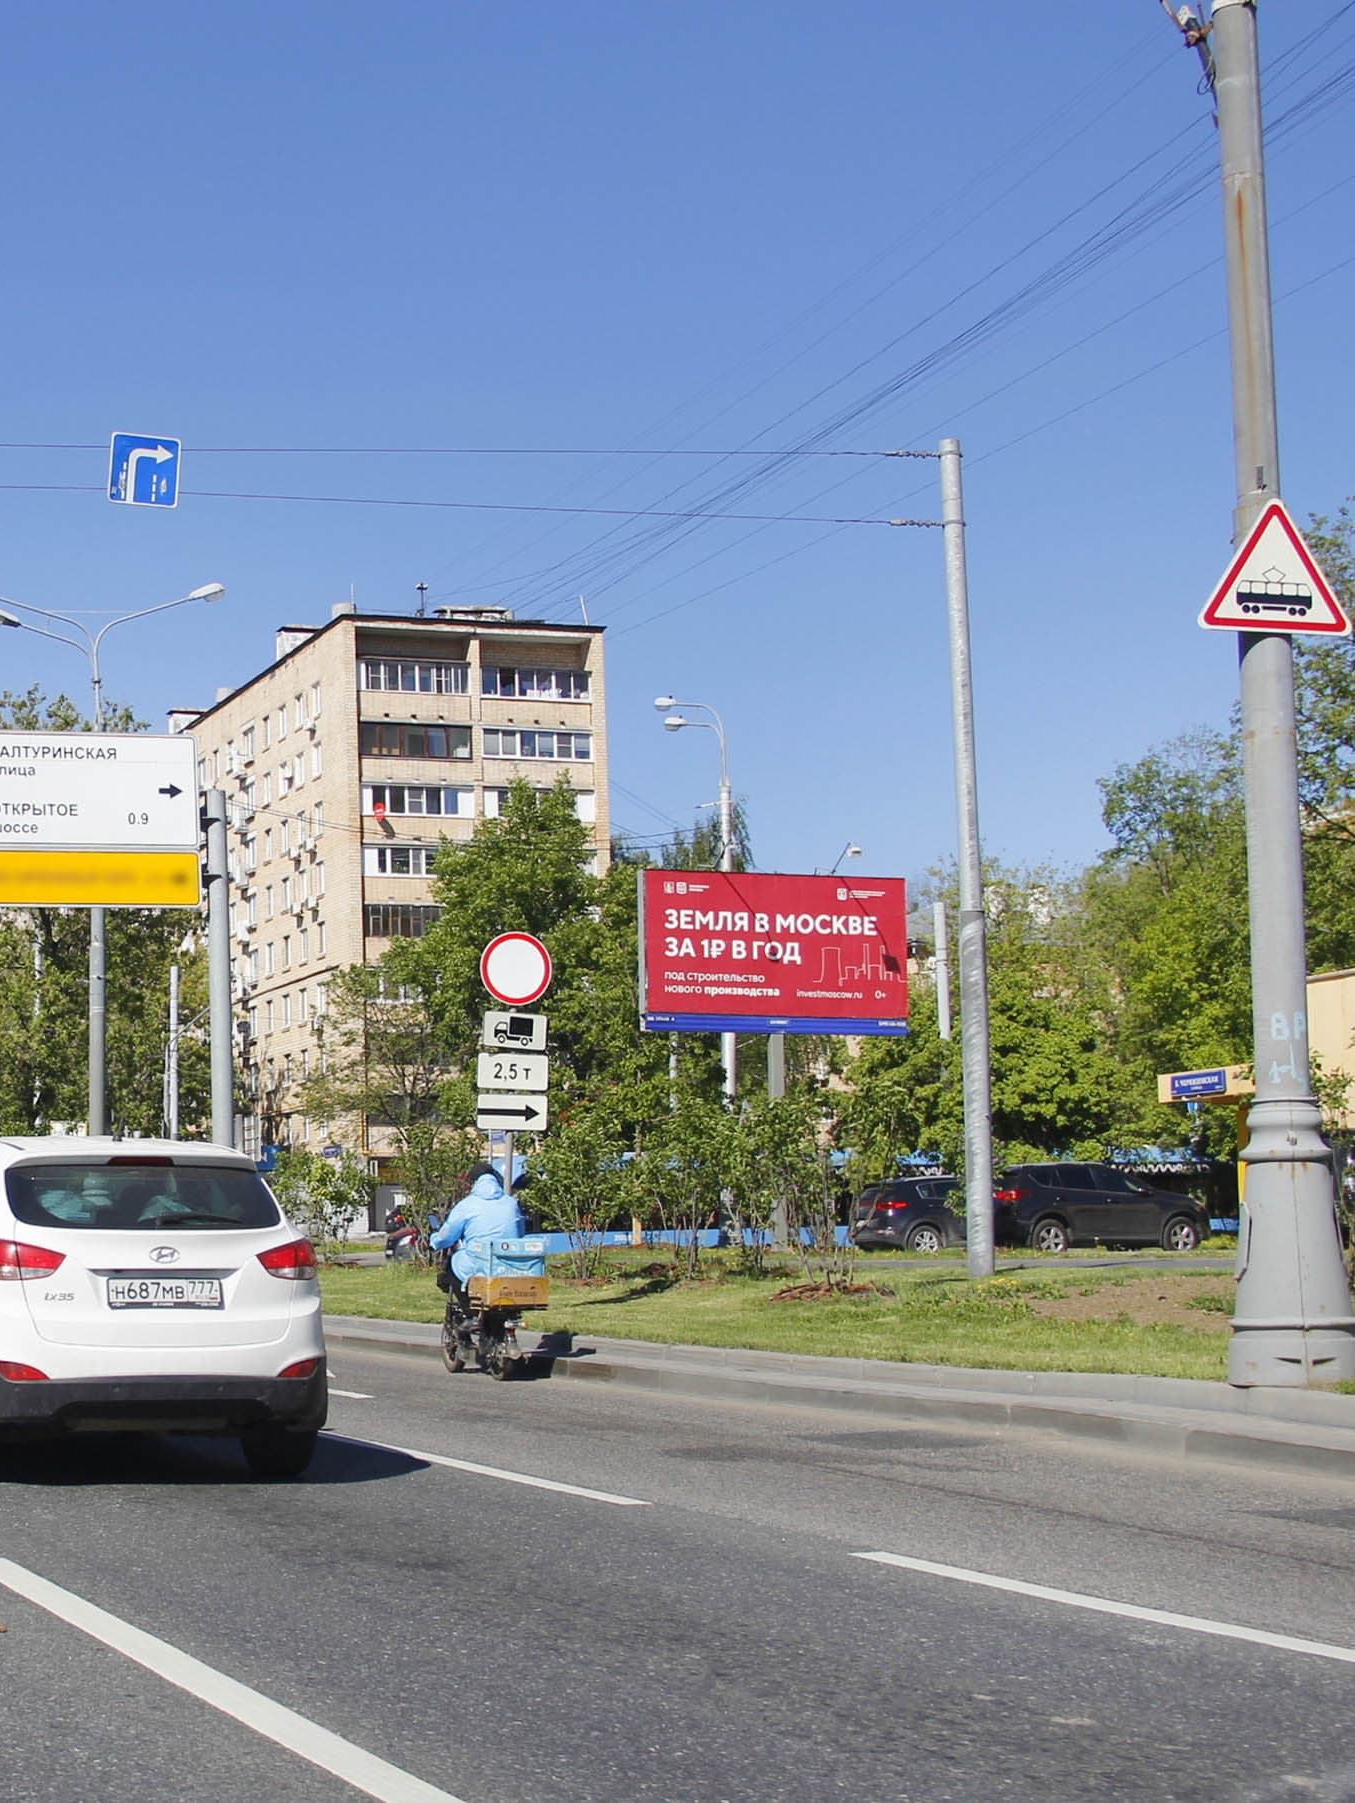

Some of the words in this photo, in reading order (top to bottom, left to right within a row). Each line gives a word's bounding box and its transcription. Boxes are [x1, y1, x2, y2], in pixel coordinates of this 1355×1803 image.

[127, 812, 149, 825] 0.9
[664, 908, 749, 932] ЗЕМЛЯ
[754, 912, 770, 933] В
[775, 913, 878, 936] МОСКВЕ
[664, 936, 697, 958] ЗА
[731, 939, 747, 960] В
[752, 940, 802, 965] ГОД
[664, 971, 685, 982] под
[686, 972, 766, 983] строительство
[664, 985, 703, 994] нового
[704, 985, 781, 997] производства
[796, 988, 863, 999] investmoscow.ru
[493, 1062, 518, 1082] 2,5
